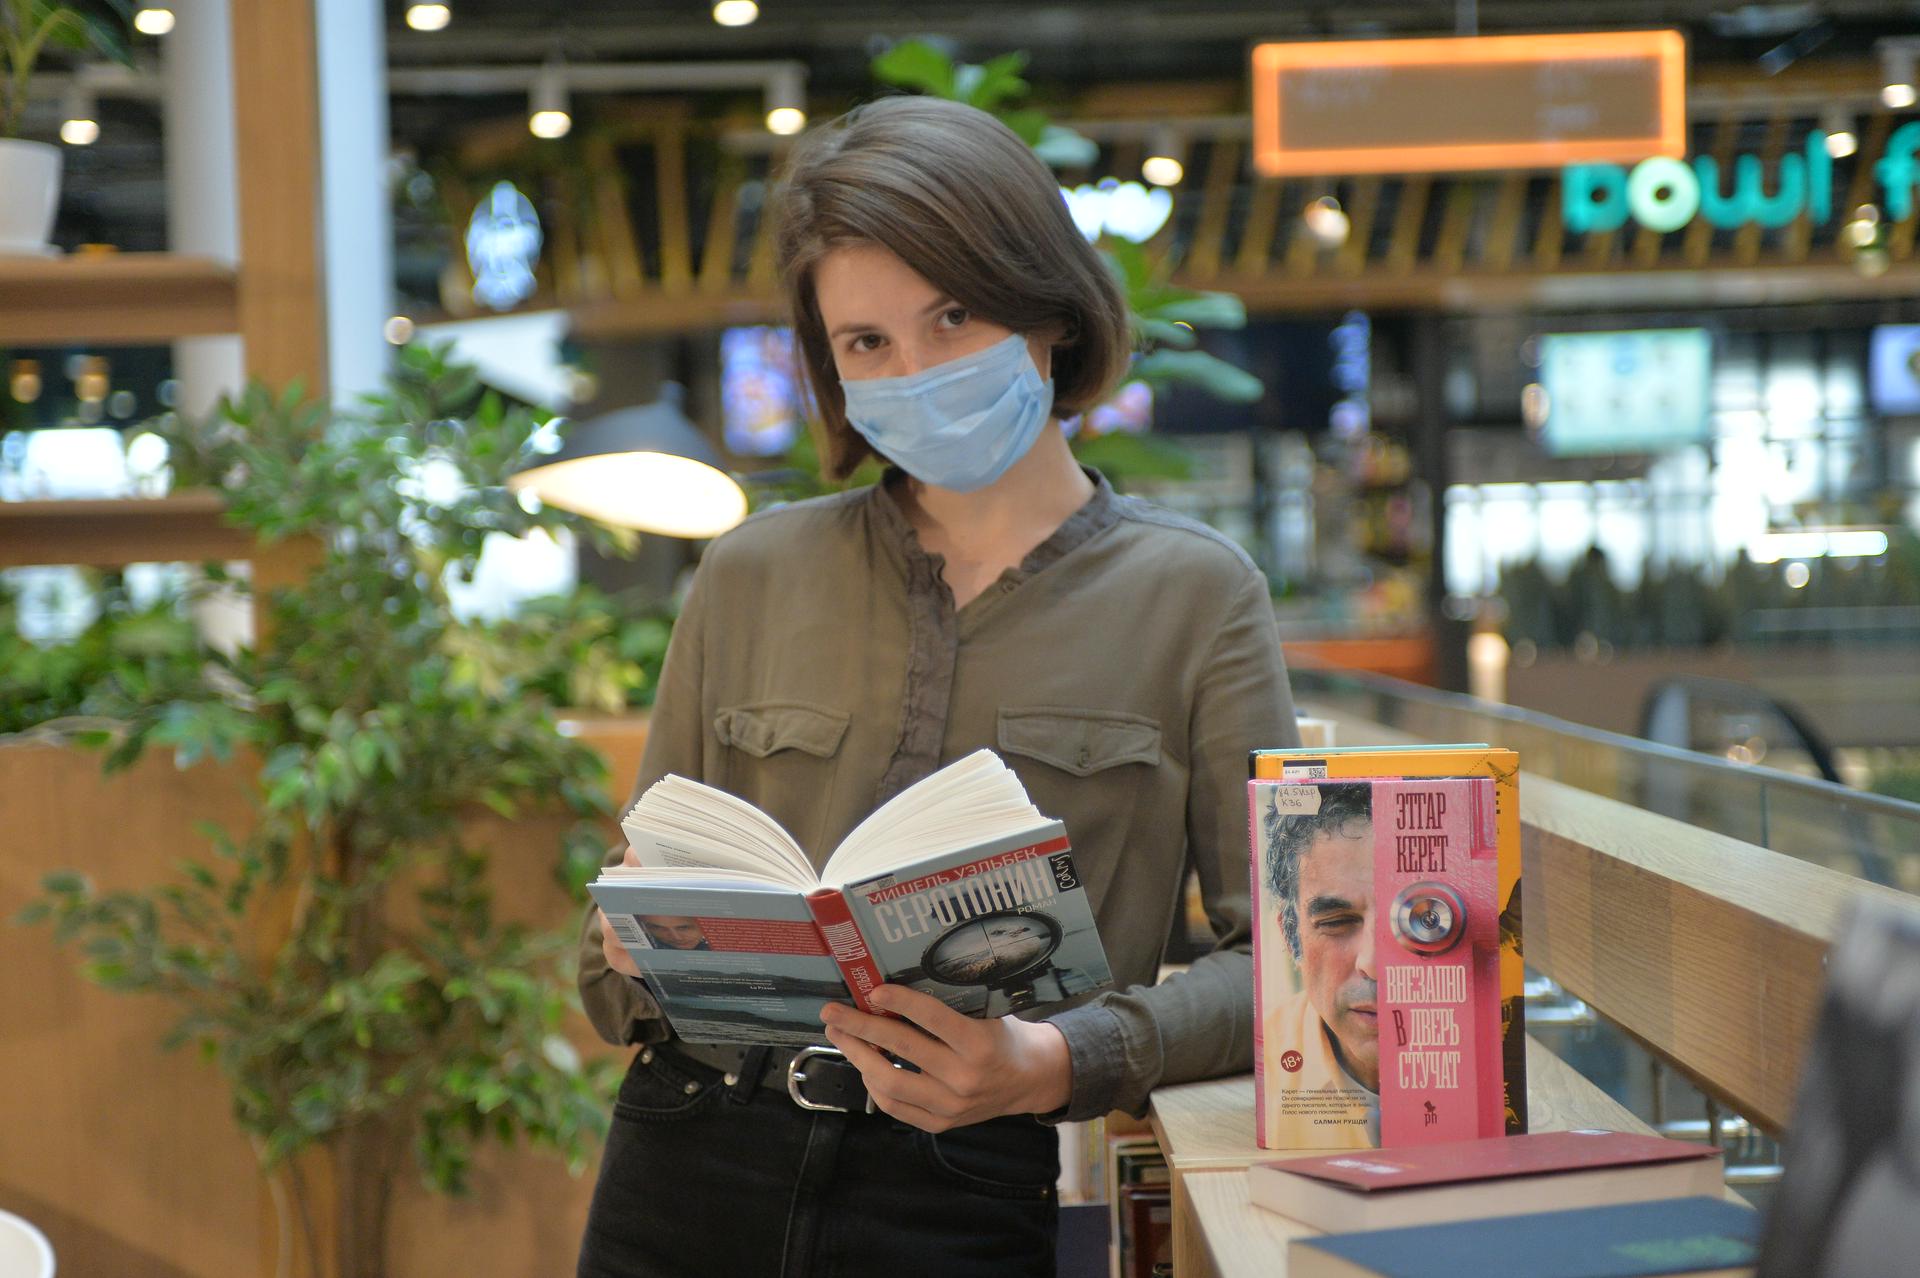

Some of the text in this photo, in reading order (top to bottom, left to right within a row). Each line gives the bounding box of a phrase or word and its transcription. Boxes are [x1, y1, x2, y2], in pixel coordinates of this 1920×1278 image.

[1395, 835, 1449, 873] КЕРЕТ
[867, 876, 950, 904] МИШЕЛЬ
[954, 847, 1038, 878] УЭЛЬБЕК
[874, 860, 1054, 943] СЕРОТОНИН
[1385, 965, 1467, 1003] ВНЕЗАПНО
[1392, 1008, 1460, 1052] В ДВЕРЬ
[1282, 1055, 1302, 1069] 18+
[1398, 1051, 1461, 1089] СТУЧАТ
